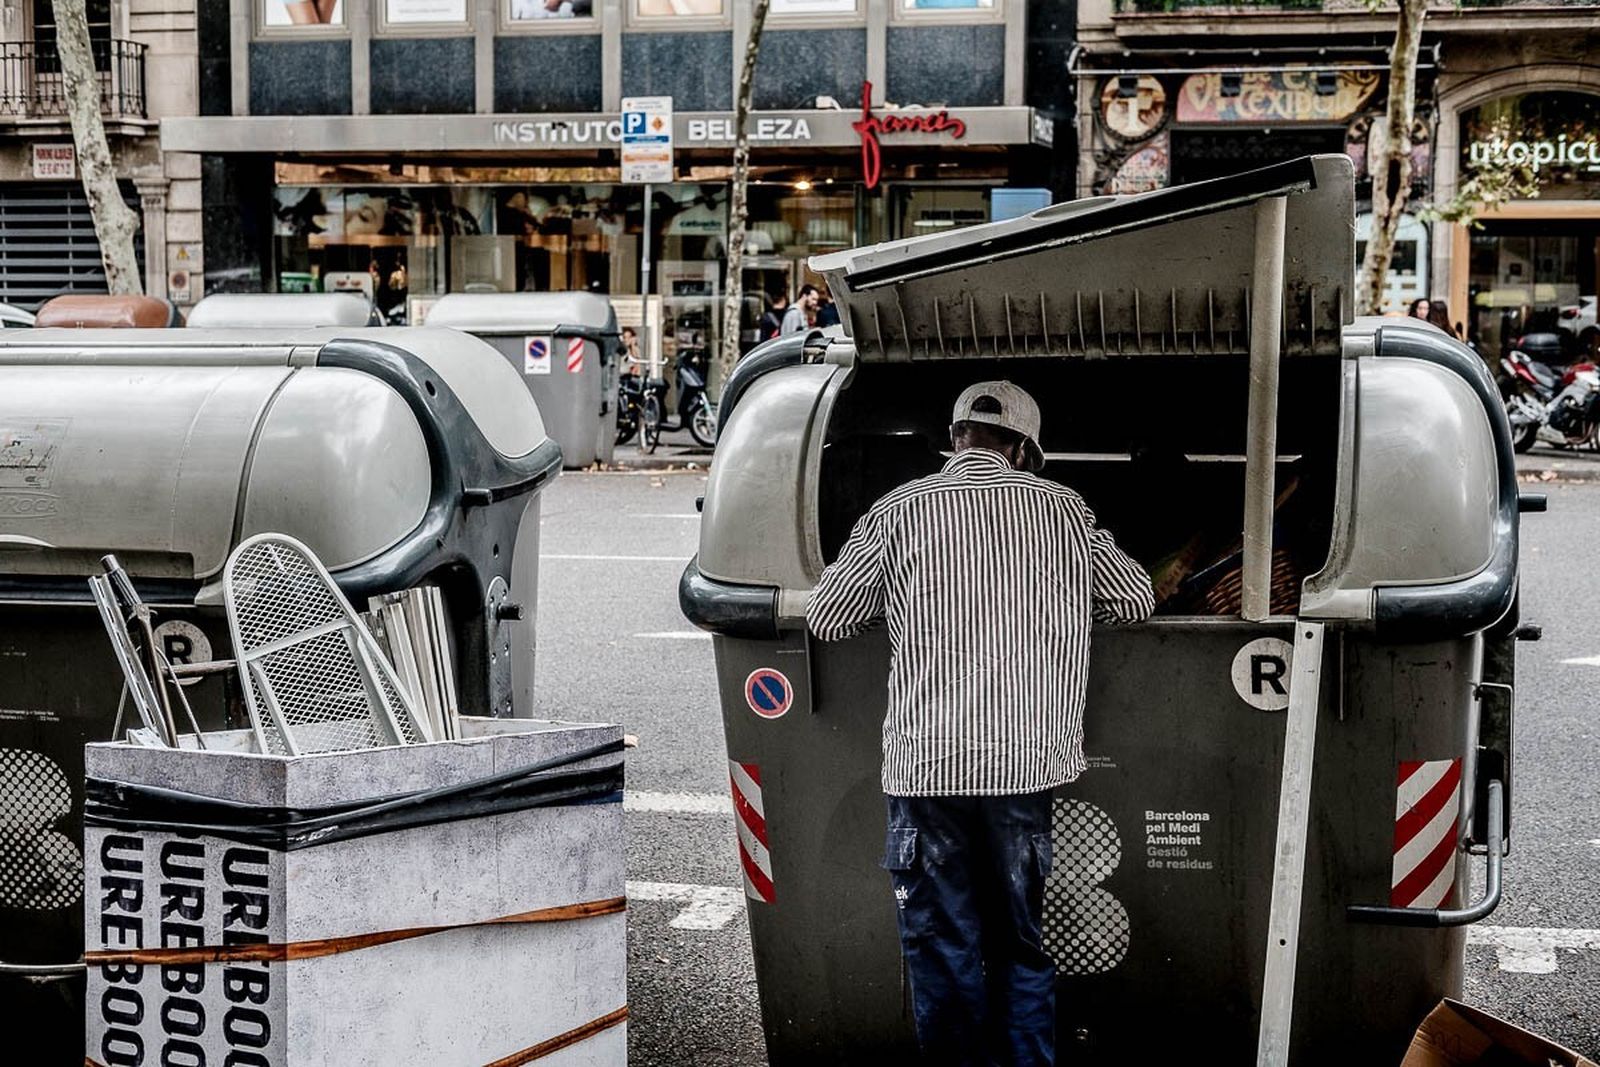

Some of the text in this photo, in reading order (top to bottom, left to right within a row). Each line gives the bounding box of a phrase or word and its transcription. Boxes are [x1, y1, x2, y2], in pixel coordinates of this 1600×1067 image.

[494, 120, 622, 143] INSTITUTO
[627, 113, 642, 133] P
[163, 634, 194, 664] R
[1250, 655, 1288, 695] R
[1145, 810, 1210, 821] Barcelona
[1146, 822, 1201, 834] pel Medi
[1146, 834, 1202, 845] Ambient
[1147, 846, 1188, 857] Gestió
[1147, 858, 1213, 870] de residus
[894, 885, 909, 900] ek
[100, 829, 145, 1067] UREBOO
[160, 834, 206, 1067] UREBOO
